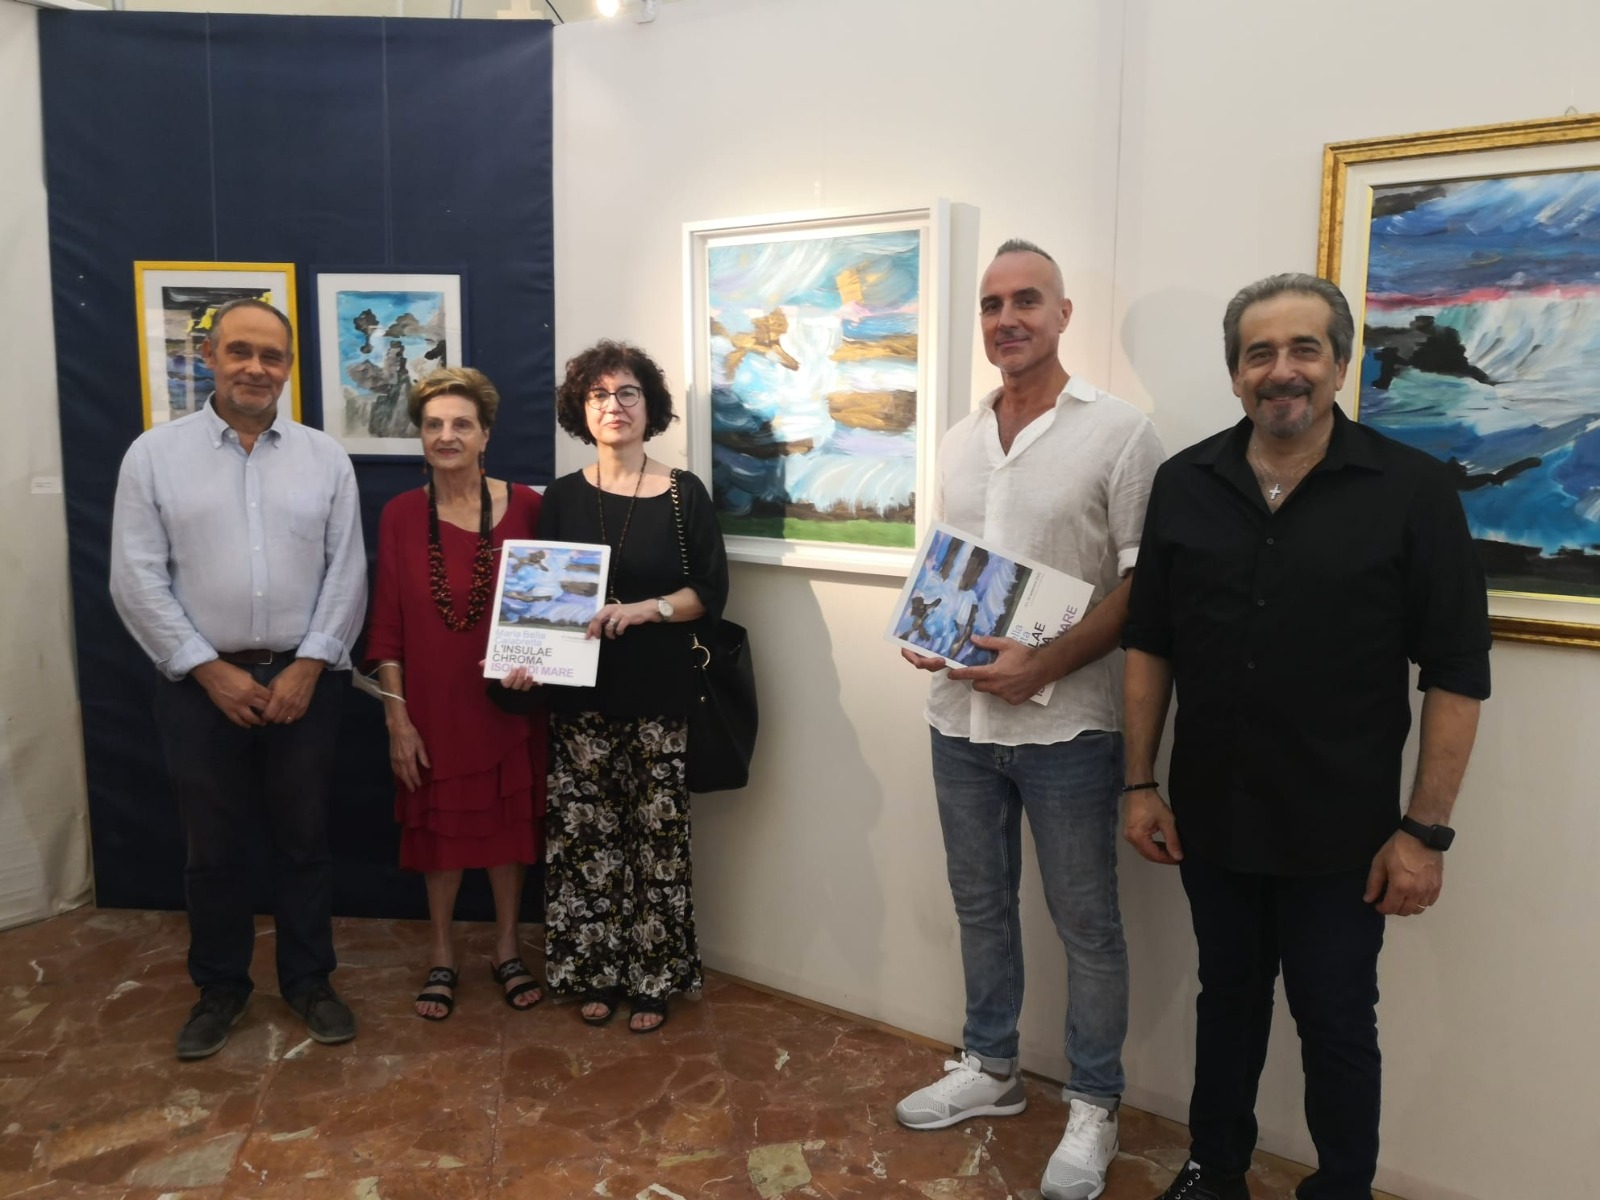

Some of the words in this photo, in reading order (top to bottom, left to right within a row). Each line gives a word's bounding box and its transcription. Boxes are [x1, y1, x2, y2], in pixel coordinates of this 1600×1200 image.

[496, 629, 521, 638] Maria
[524, 630, 547, 639] Bella
[1011, 625, 1023, 641] ella
[494, 645, 553, 657] L'INSULAE
[492, 653, 543, 666] CHROMA
[527, 666, 539, 675] DI
[541, 667, 574, 678] MARE
